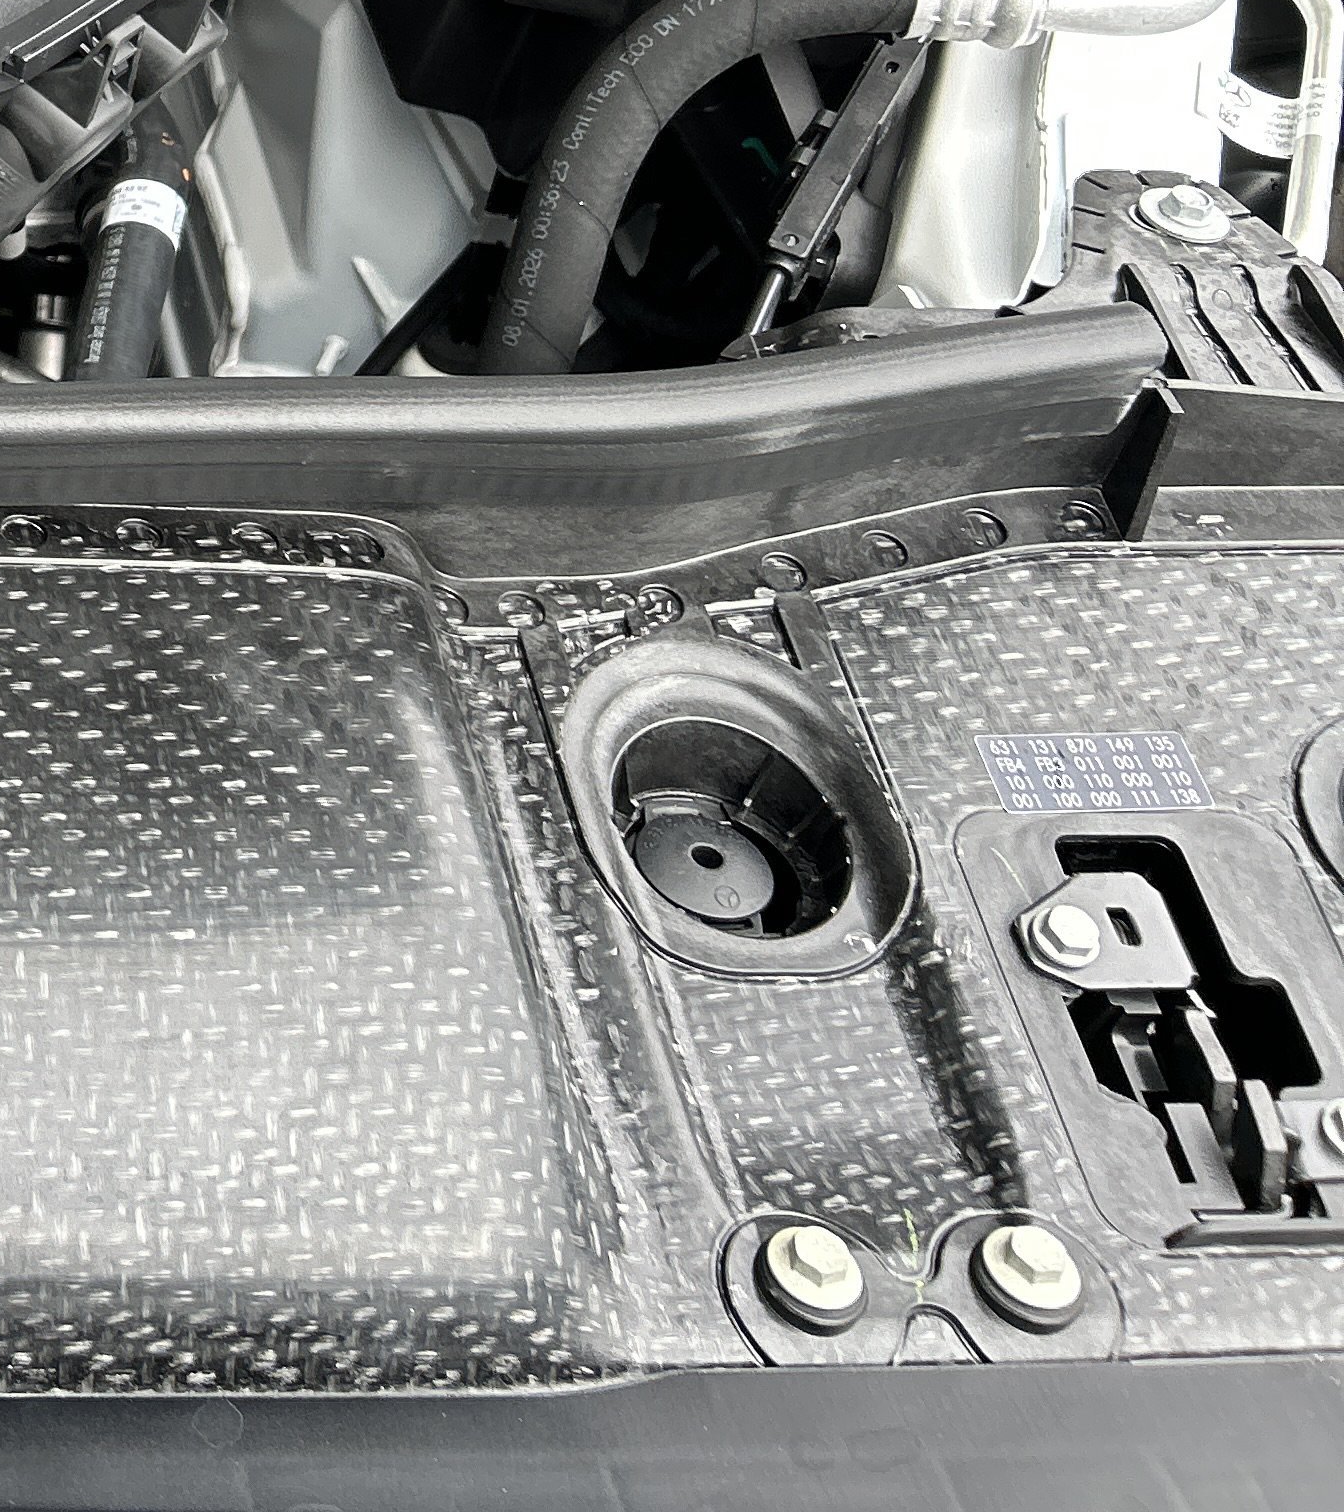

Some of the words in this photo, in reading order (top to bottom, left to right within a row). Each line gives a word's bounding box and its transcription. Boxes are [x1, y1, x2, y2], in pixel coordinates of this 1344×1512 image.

[562, 69, 625, 150] ContiTech
[652, 13, 681, 37] DN
[989, 740, 1019, 755] 631
[1028, 739, 1058, 755] 131
[1065, 738, 1098, 754] 870
[1105, 737, 1134, 753] 149
[1144, 736, 1176, 752] 135
[1073, 756, 1105, 771] 011
[1112, 755, 1144, 770] 001
[1152, 754, 1183, 769] 001
[1004, 775, 1035, 791] 101
[1042, 774, 1075, 790] 000
[1083, 773, 1114, 789] 110
[1120, 772, 1153, 788] 000
[1161, 771, 1193, 787] 110
[1012, 793, 1043, 809] 001
[1052, 792, 1083, 808] 100
[1090, 791, 1122, 807] 000
[1130, 790, 1162, 805] 111
